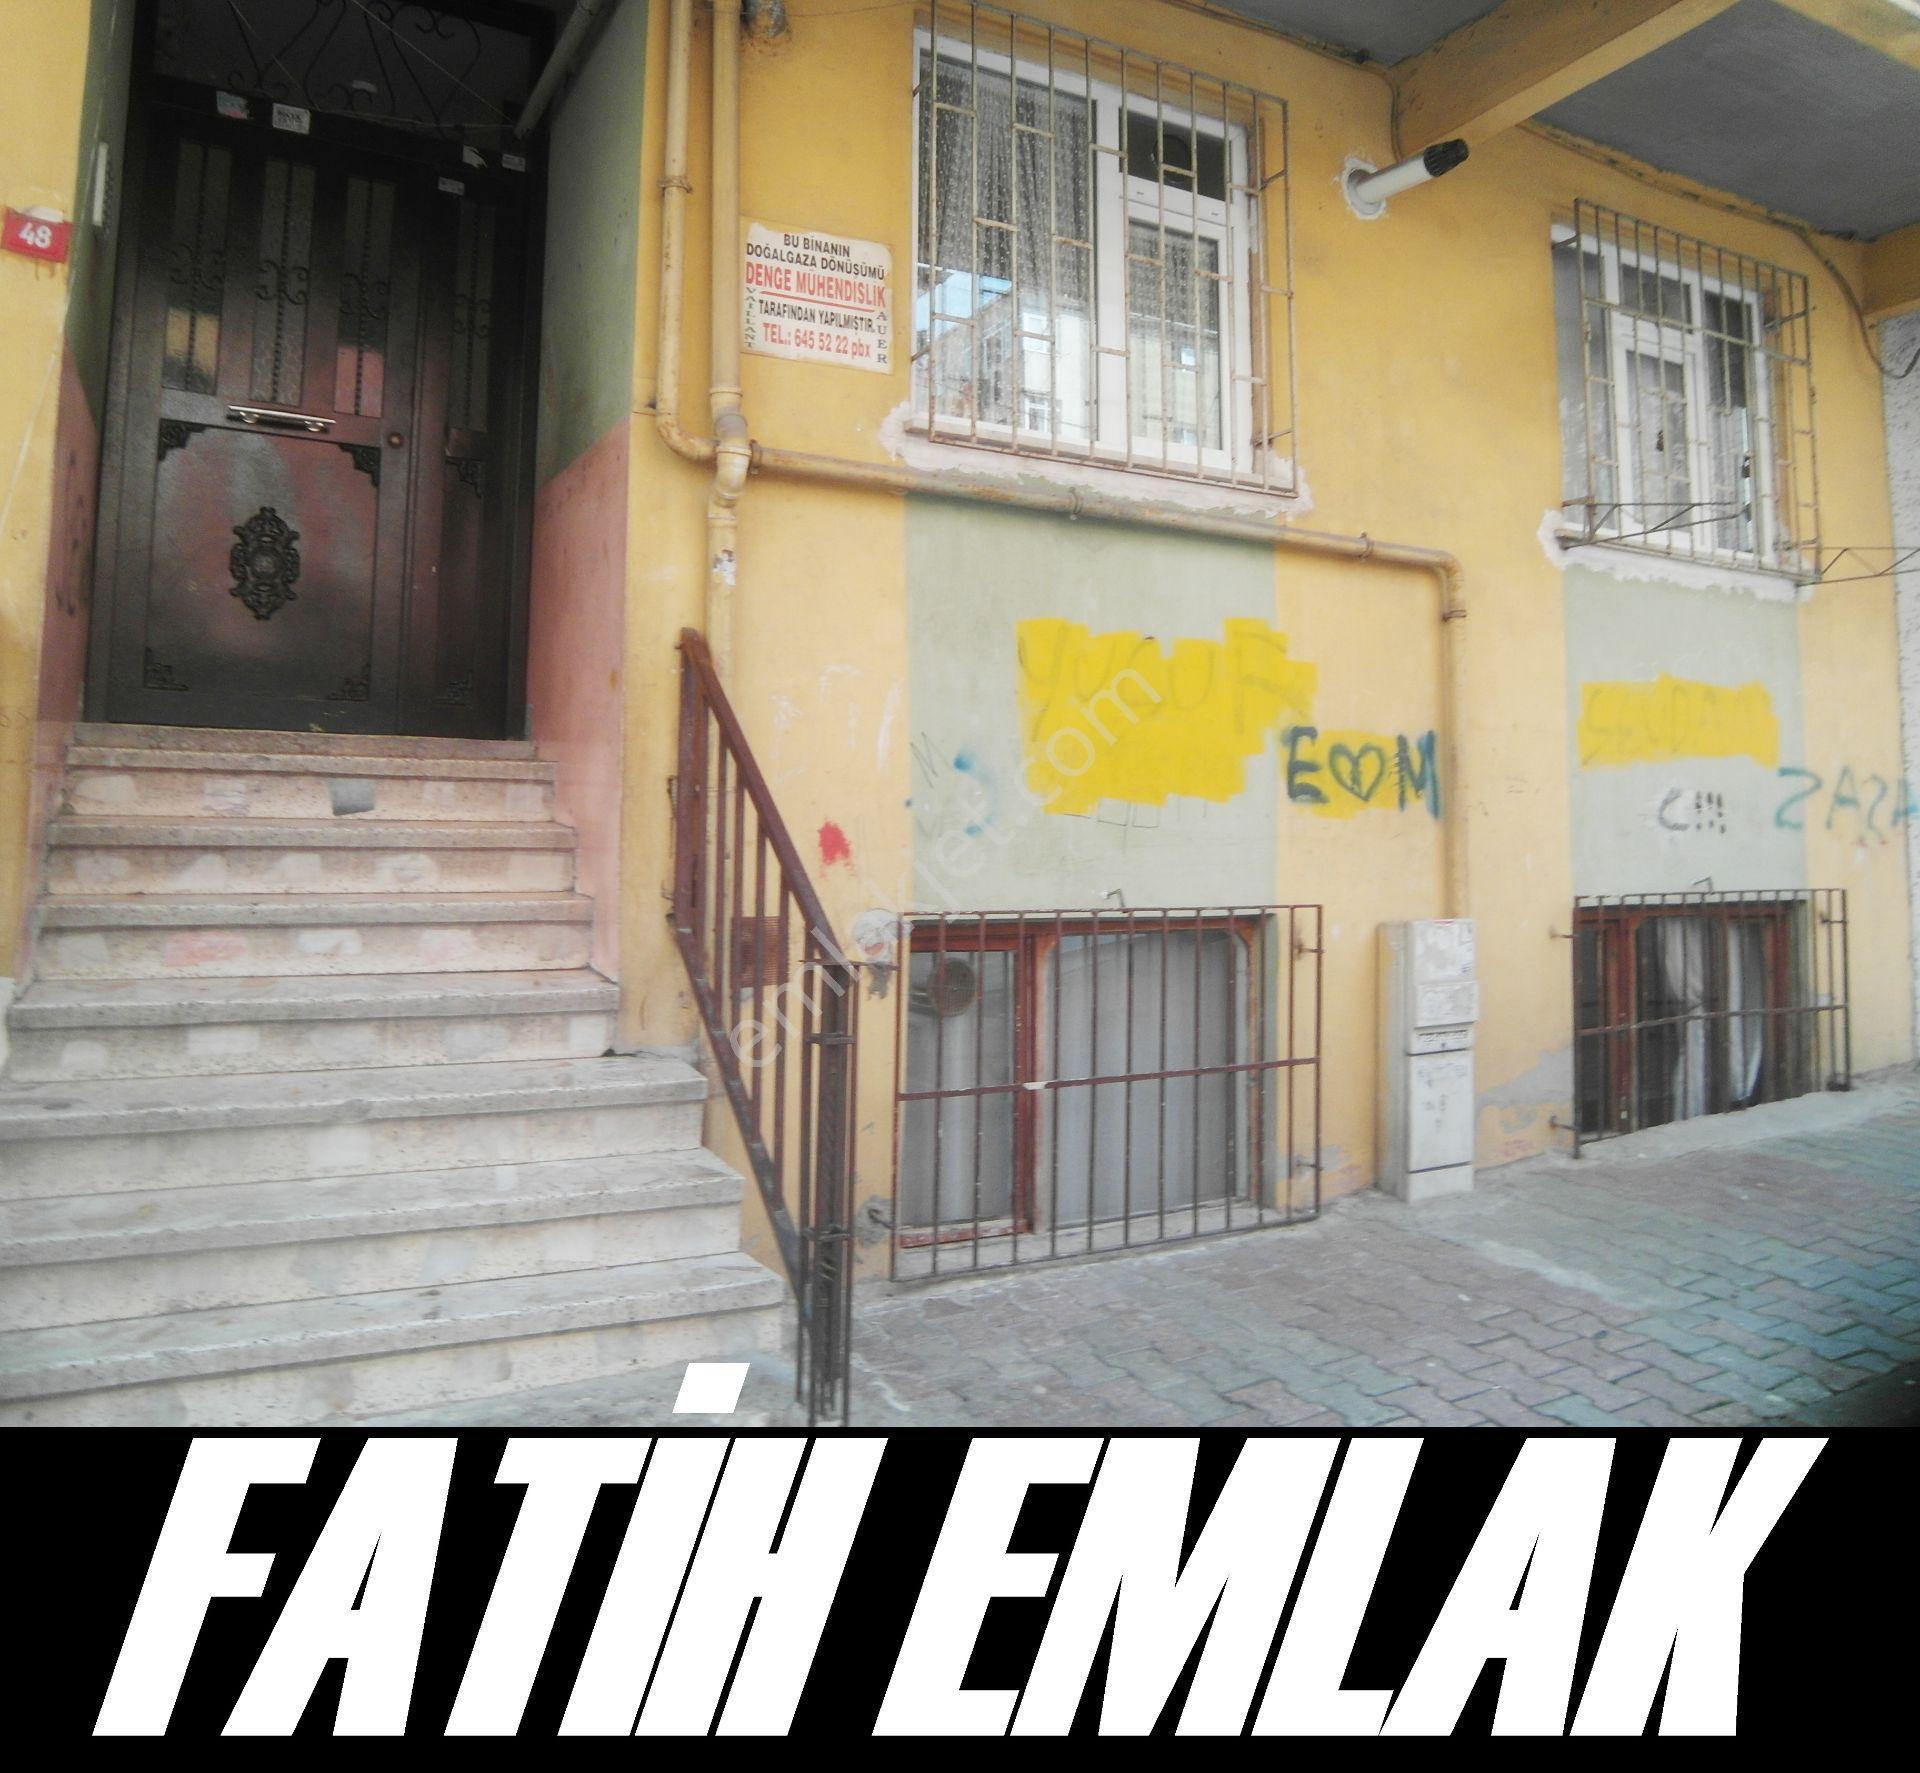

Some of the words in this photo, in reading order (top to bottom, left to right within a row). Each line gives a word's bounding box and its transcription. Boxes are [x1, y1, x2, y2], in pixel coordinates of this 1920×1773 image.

[18, 222, 52, 248] 48
[784, 233, 799, 248] BU
[803, 236, 850, 258] BİNANIN
[746, 243, 817, 268] DOĞALGAZA
[746, 262, 791, 292] DENGE
[758, 299, 816, 323] TARAFINDAN
[795, 328, 815, 349] 645
[819, 332, 832, 352] 52
[835, 335, 848, 354] 22
[851, 338, 871, 360] pbx
[876, 311, 888, 364] AUER
